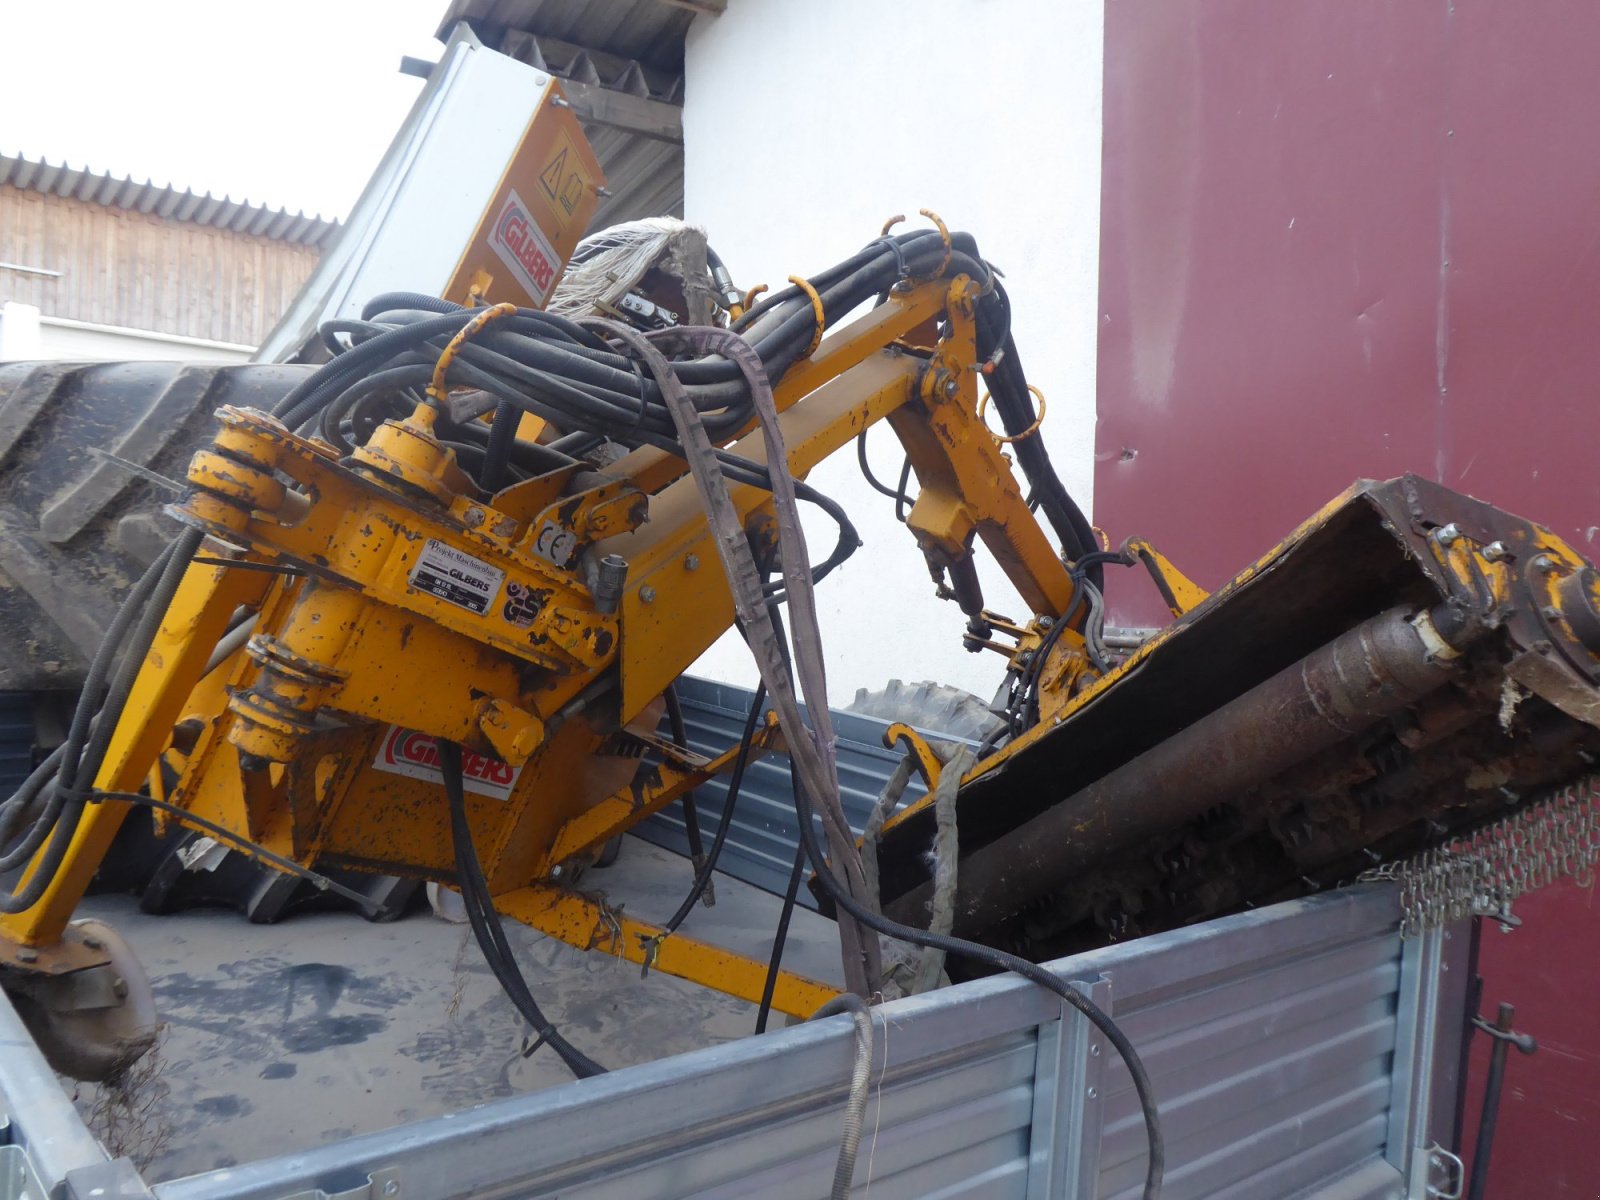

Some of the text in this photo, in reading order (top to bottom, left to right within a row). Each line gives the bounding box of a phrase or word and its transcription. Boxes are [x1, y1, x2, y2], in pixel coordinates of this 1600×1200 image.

[504, 215, 555, 292] GILBERS
[537, 526, 567, 560] CE
[449, 567, 490, 592] GILBERS
